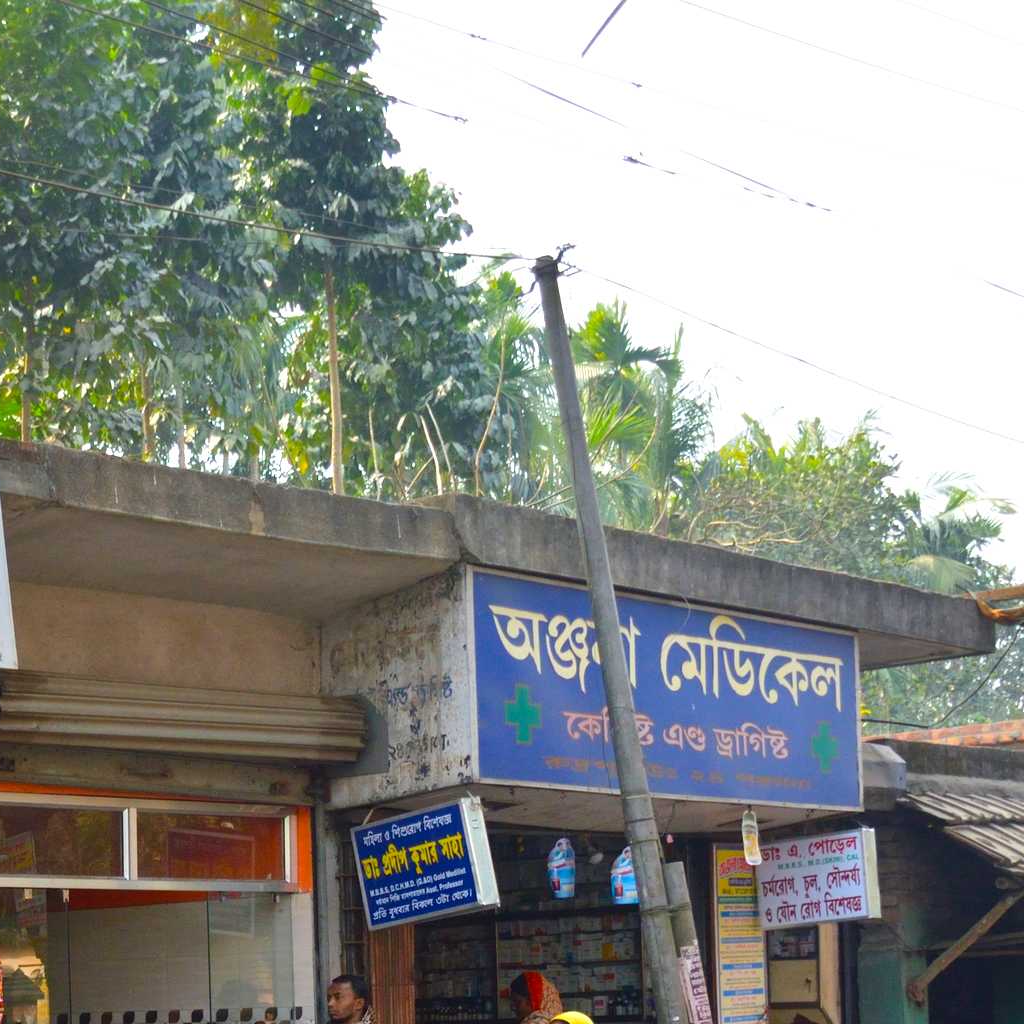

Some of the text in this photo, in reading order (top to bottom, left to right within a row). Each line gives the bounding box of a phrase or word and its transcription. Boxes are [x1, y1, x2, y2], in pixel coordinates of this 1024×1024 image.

[660, 614, 845, 712] মেডিকেল
[361, 855, 381, 880] ডাঃ
[408, 840, 440, 875] কুমার
[808, 836, 857, 857] পোড়েল
[765, 908, 773, 922] ও
[777, 900, 797, 923] যৌন
[801, 900, 822, 920] রোগ
